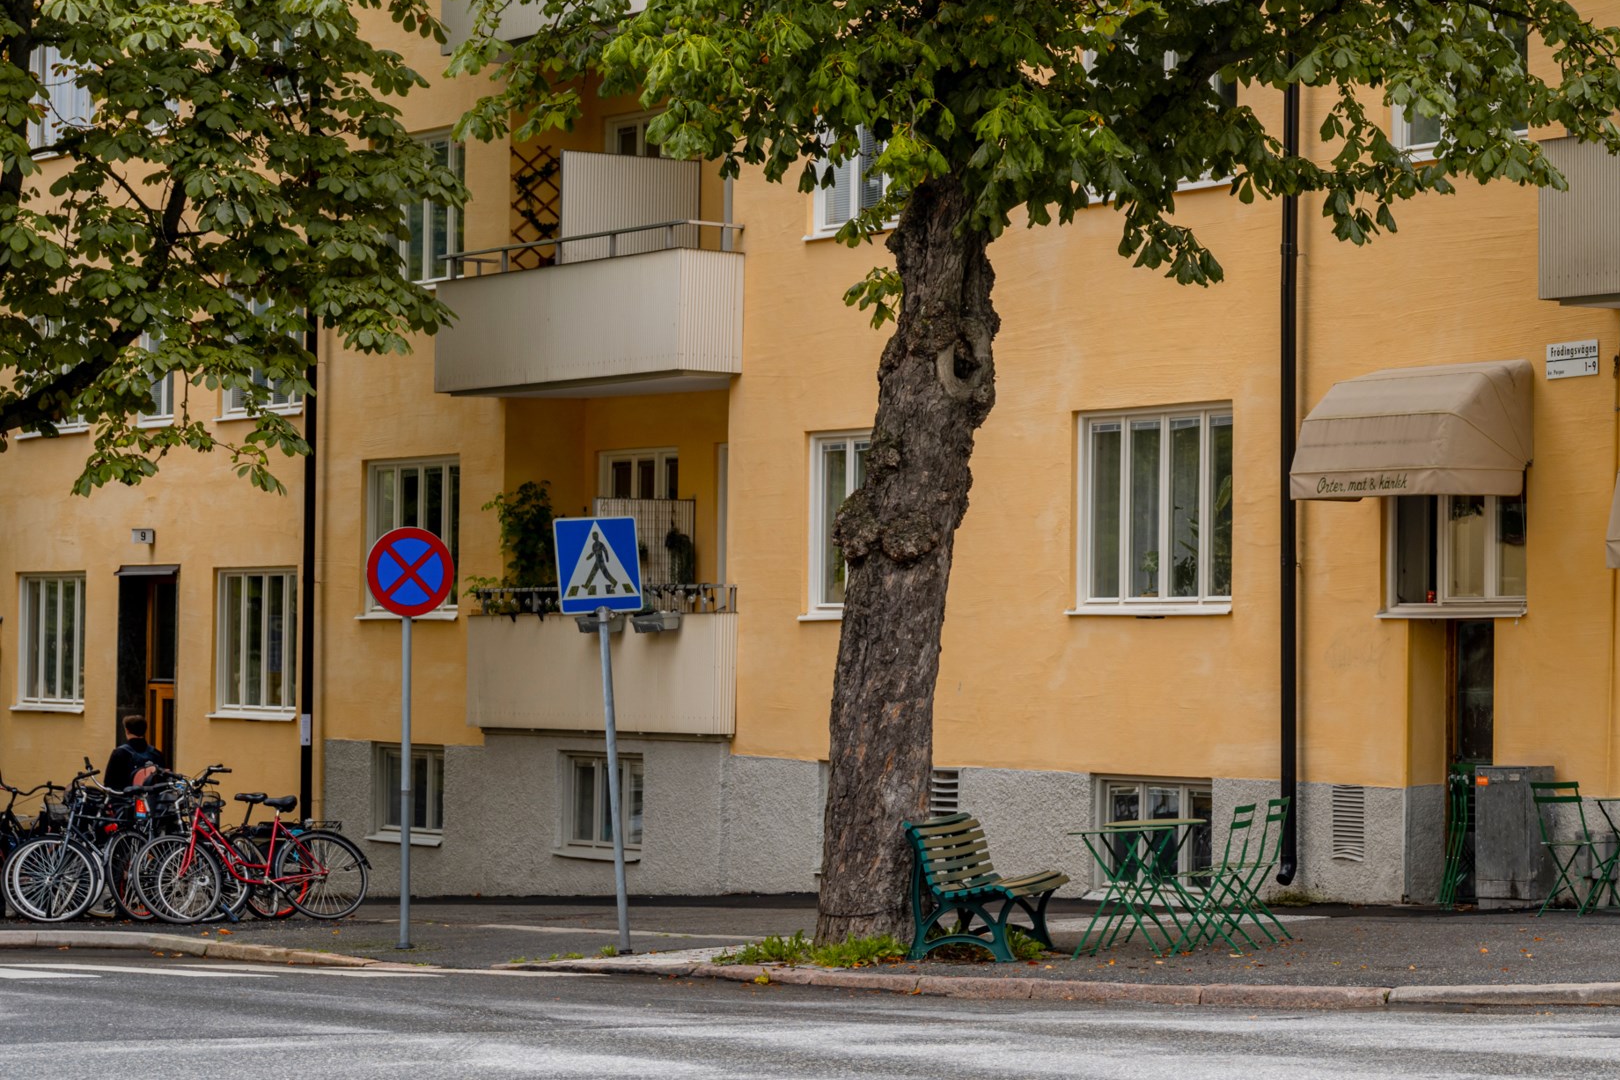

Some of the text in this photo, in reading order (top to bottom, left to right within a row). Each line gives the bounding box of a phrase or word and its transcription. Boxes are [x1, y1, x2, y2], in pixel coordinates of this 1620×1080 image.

[1550, 344, 1597, 357] Frödingsvägen
[1584, 360, 1597, 372] 1-9
[1347, 477, 1368, 491] mat
[1369, 478, 1376, 491] &
[140, 531, 146, 541] 9
